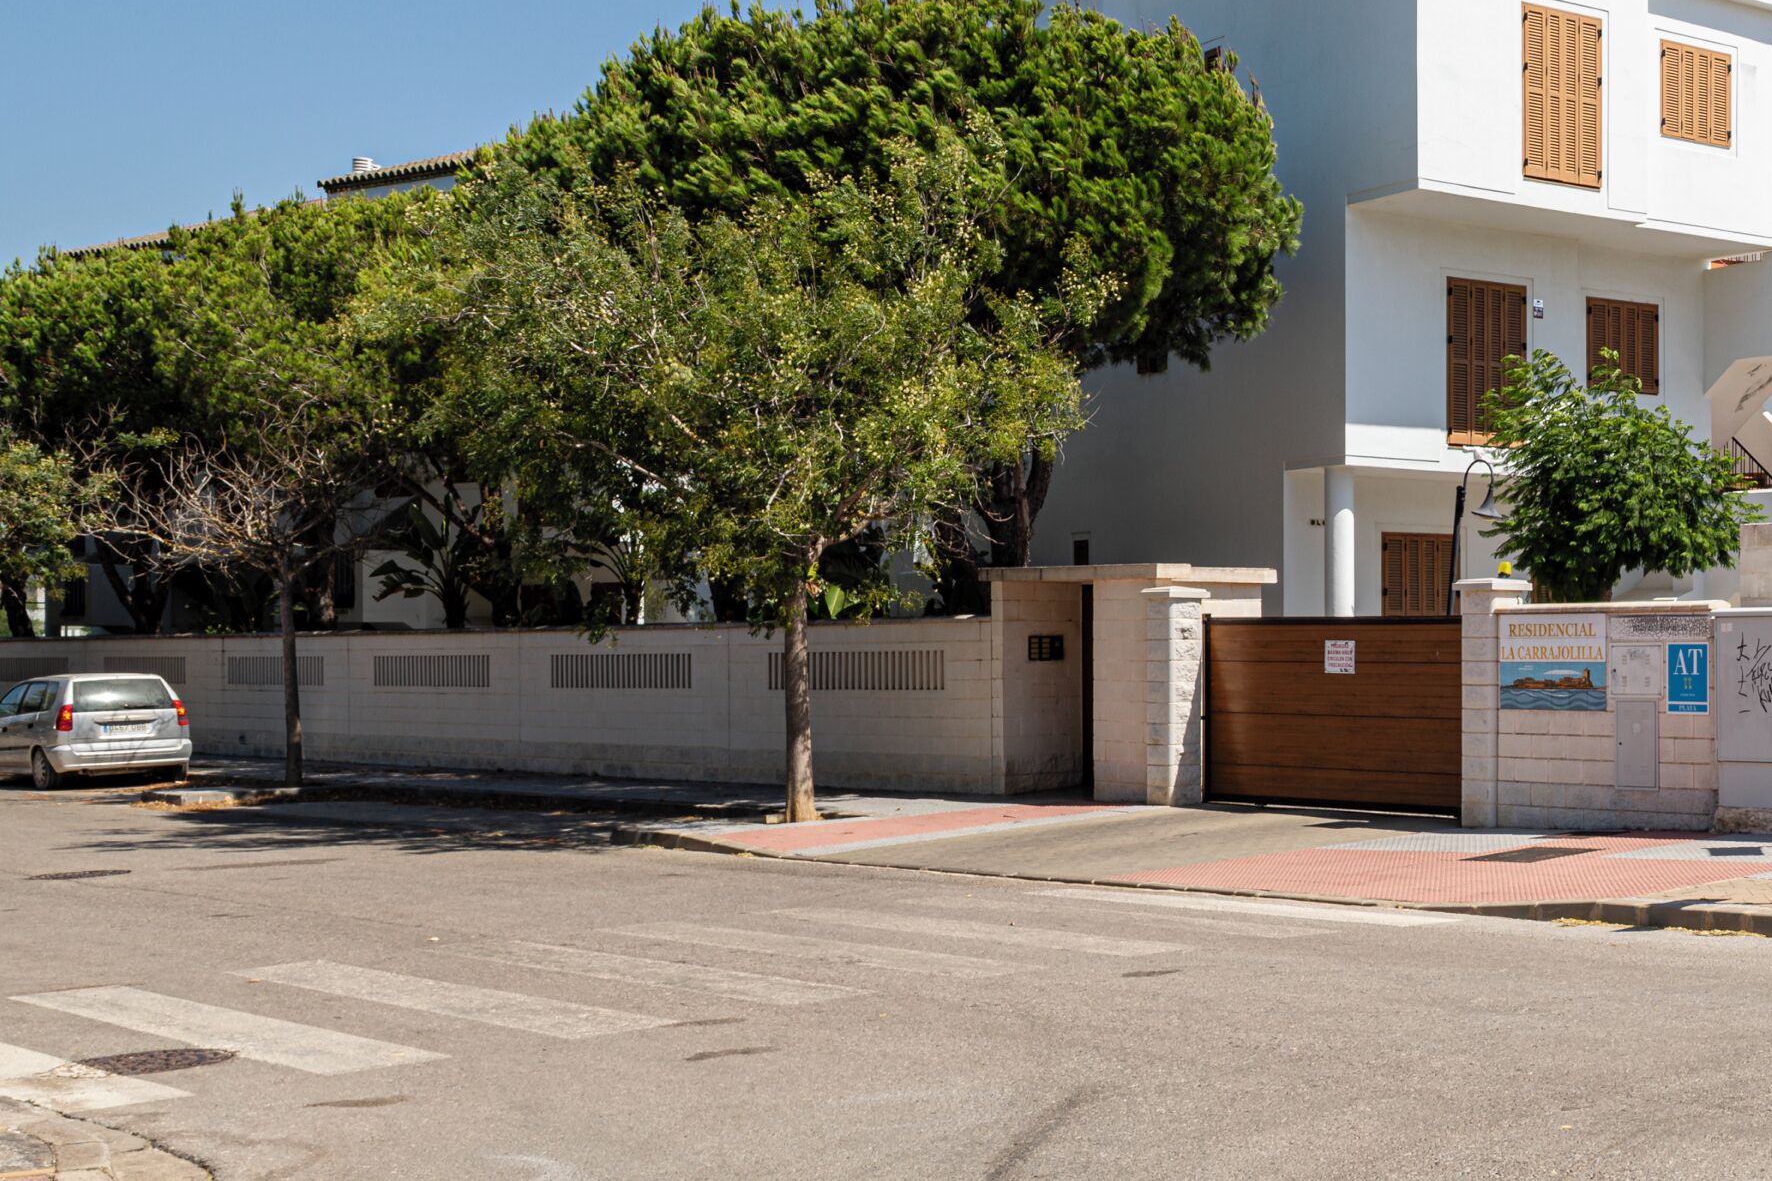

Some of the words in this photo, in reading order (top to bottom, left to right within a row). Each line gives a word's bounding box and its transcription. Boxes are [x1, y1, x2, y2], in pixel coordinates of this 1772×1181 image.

[1508, 623, 1596, 637] RESIDENCIAL
[1501, 646, 1515, 660] LA
[1517, 645, 1603, 660] CARRAJOLILLA
[1673, 648, 1703, 675] AT
